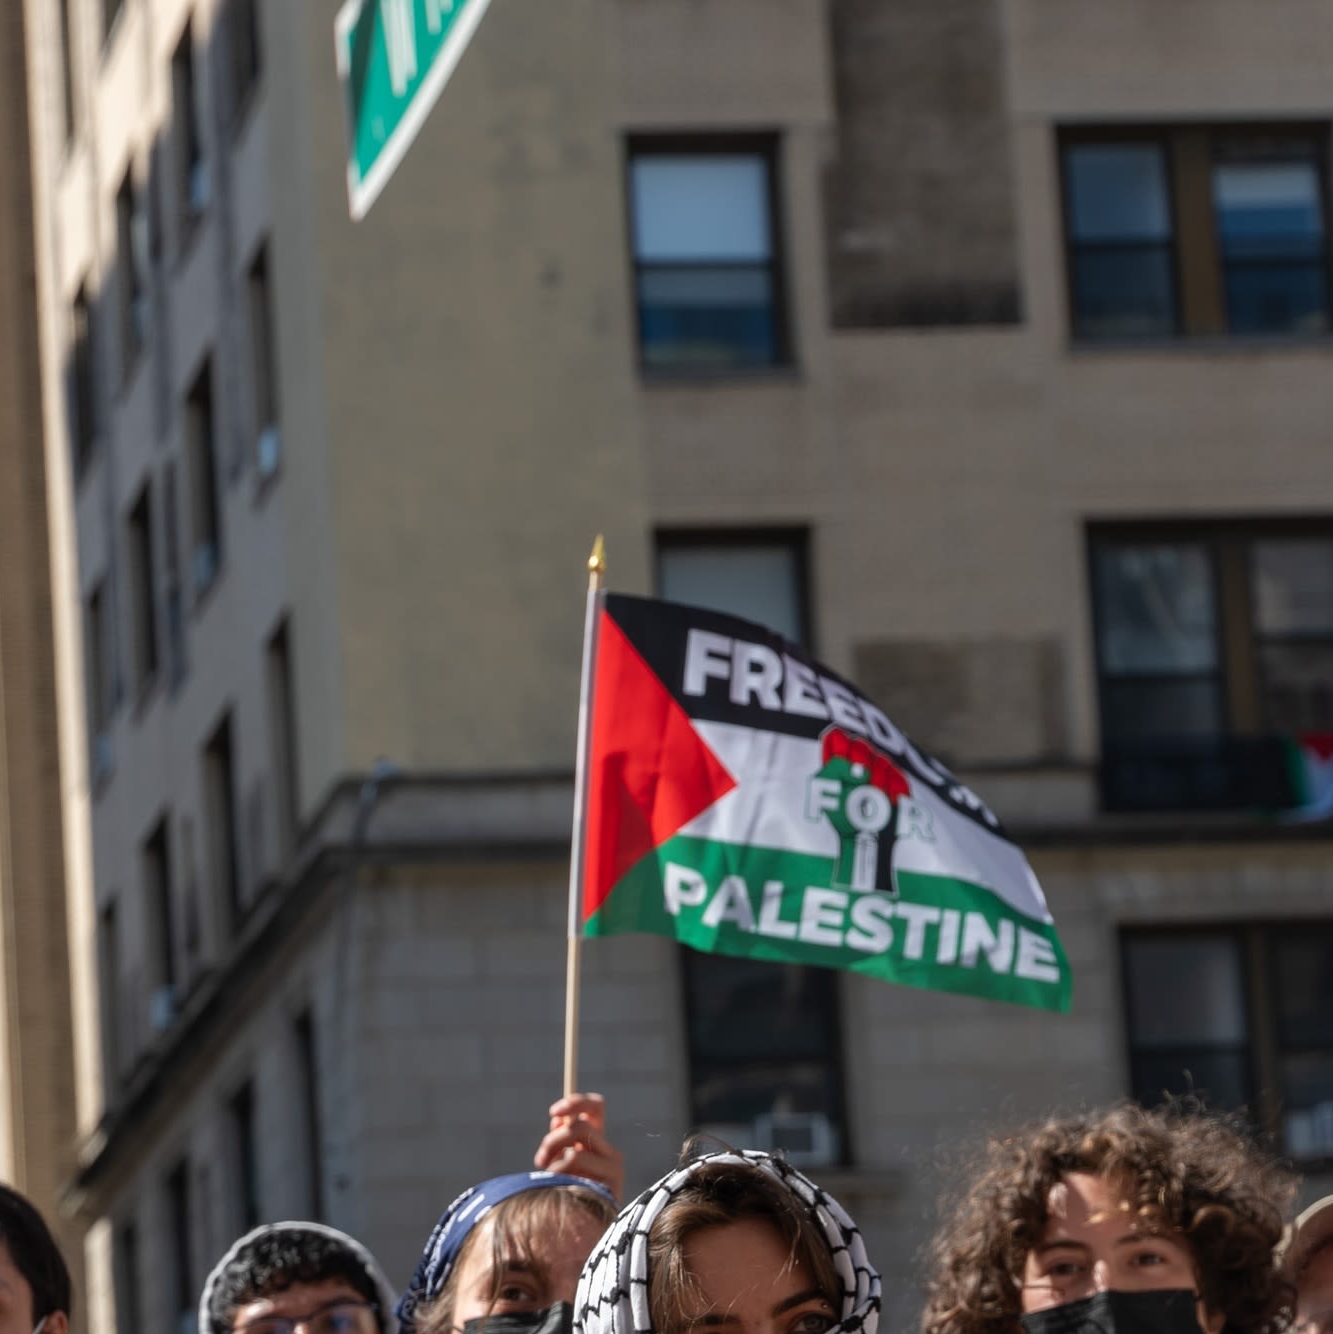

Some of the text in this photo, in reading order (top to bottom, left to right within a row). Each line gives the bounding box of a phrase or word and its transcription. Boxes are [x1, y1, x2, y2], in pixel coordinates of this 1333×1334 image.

[683, 627, 1000, 828] FREED
[807, 774, 936, 842] FOR
[663, 862, 1061, 984] PALESTINE
